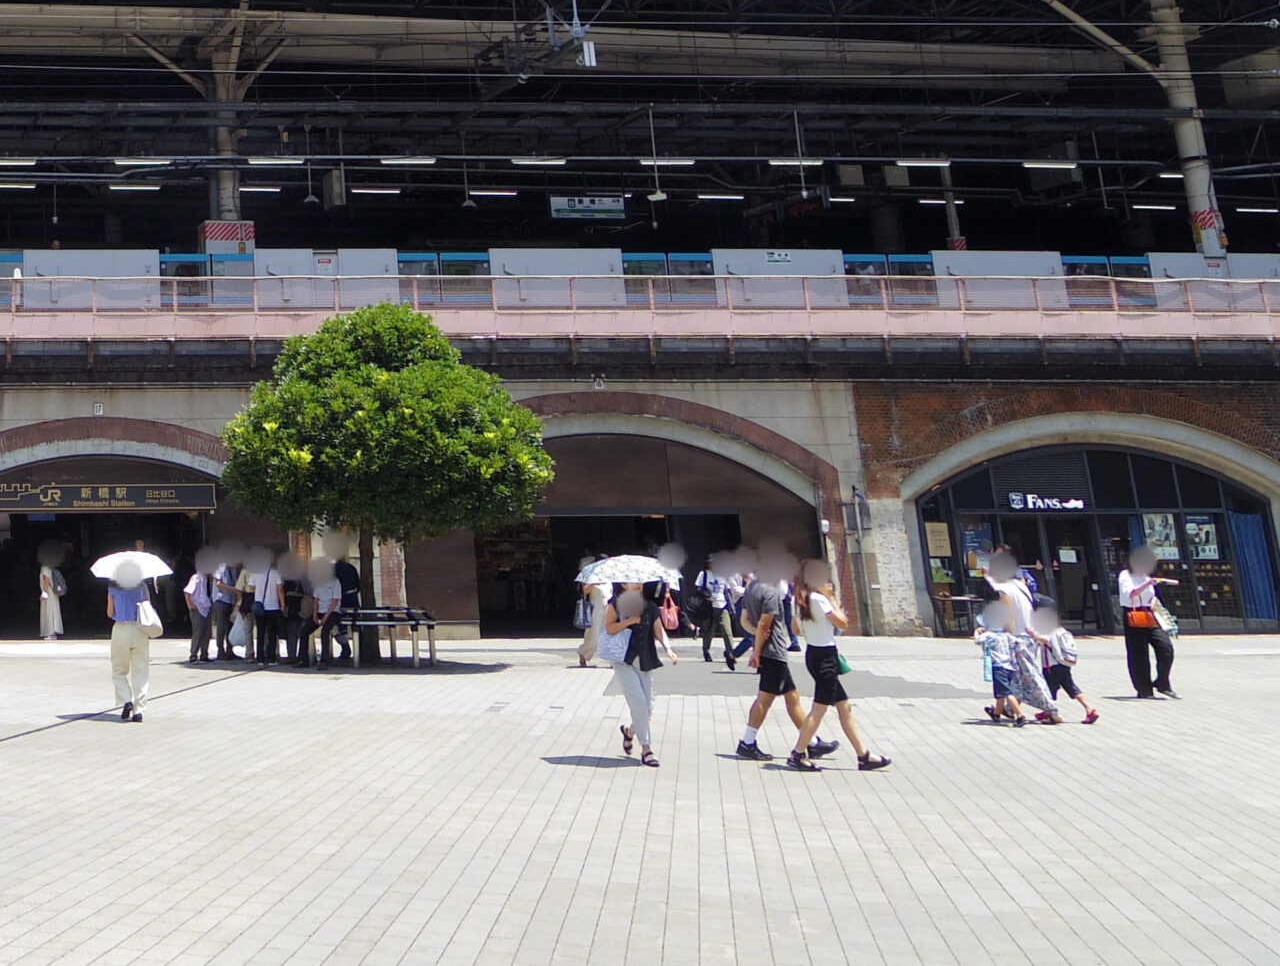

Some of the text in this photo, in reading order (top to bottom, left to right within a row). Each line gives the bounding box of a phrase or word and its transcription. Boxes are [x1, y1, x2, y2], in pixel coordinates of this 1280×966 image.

[39, 489, 61, 502] JR
[80, 487, 127, 499] 新橋駅
[145, 489, 176, 498] 日比谷口
[73, 499, 135, 507] Shimbashi Station
